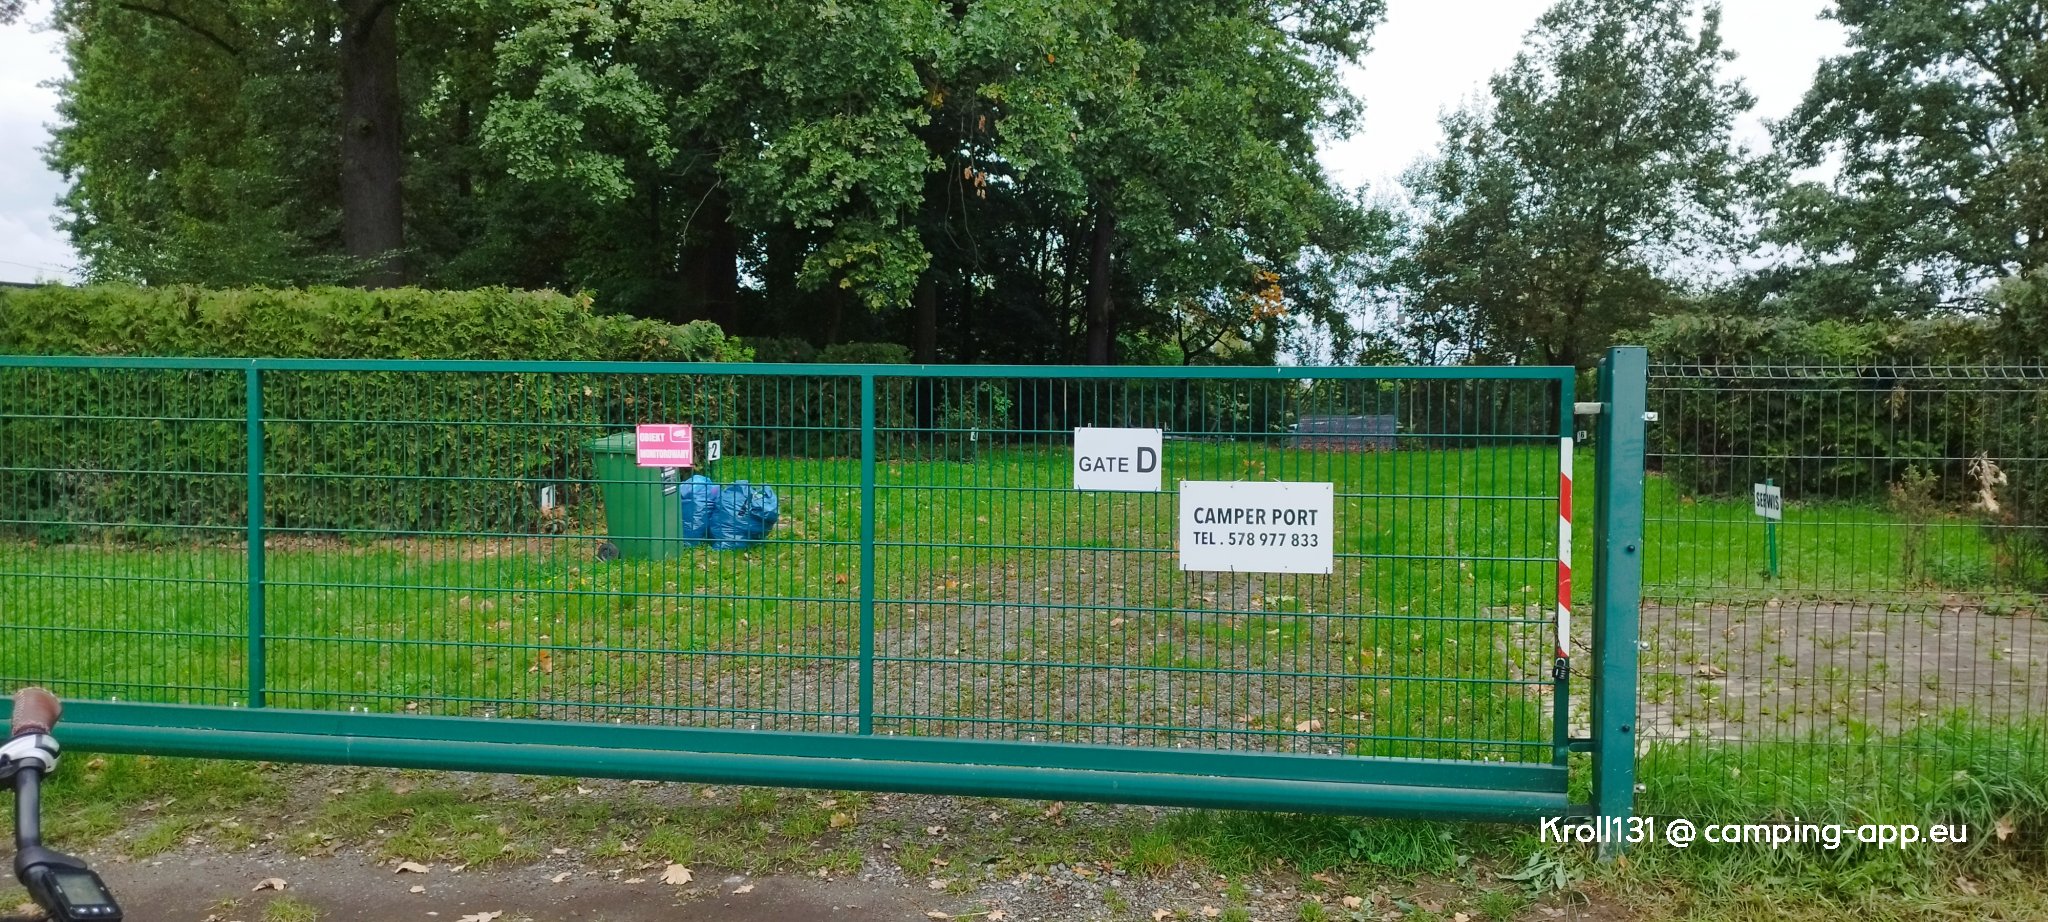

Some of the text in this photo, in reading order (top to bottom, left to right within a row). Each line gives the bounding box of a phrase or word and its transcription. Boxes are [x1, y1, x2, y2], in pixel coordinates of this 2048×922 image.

[711, 442, 718, 459] 2
[1078, 447, 1157, 473] GATE D
[1756, 491, 1780, 511] SERWIS
[1193, 507, 1318, 526] CAMPER PORT
[1228, 532, 1255, 546] 578
[1260, 532, 1286, 547] 977
[1291, 533, 1319, 548] 833
